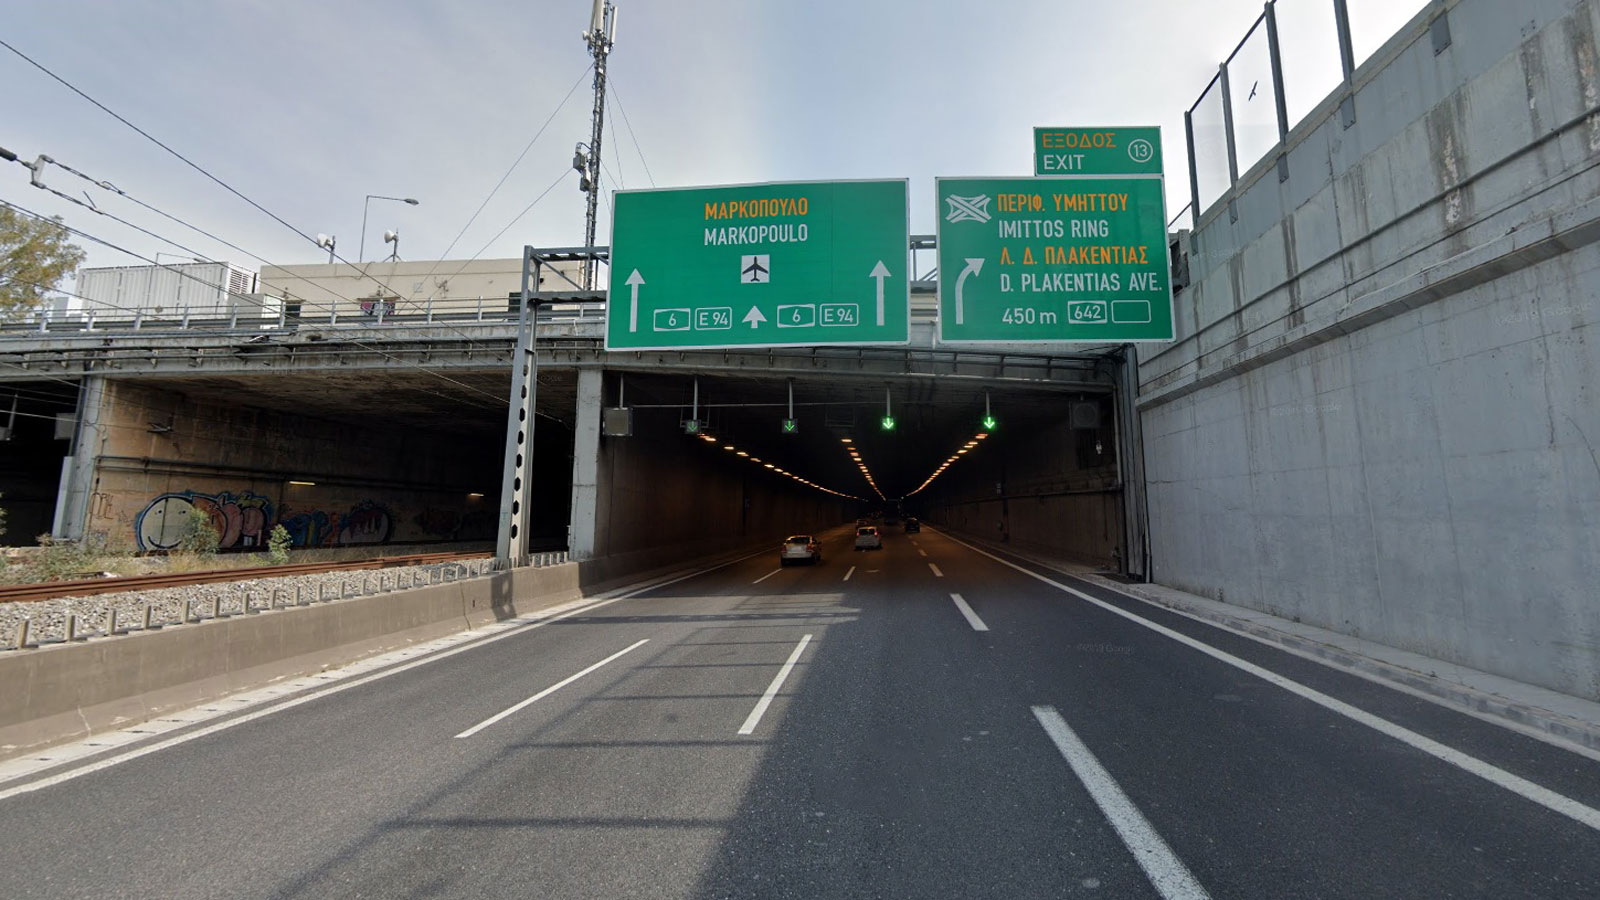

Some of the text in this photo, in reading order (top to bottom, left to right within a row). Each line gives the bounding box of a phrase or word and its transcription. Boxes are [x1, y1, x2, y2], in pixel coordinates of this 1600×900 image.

[1042, 133, 1116, 148] ΕΞΟΔΟΣ
[1133, 144, 1148, 157] 13
[1043, 154, 1084, 170] EXIT
[704, 197, 808, 220] ΜΑΡΚΟΠΟΥΛΟ
[998, 193, 1128, 212] ΠΕΡΙΦ. ΥΜΗΤΤΟΥ
[703, 224, 808, 246] MARKOPOULO
[998, 220, 1109, 238] IMITTOS RING
[1000, 246, 1149, 265] Λ. Δ. ΠΛΑΚΕΝΤΙΑΣ
[1000, 272, 1162, 292] D. PLAKENTIAS AVE.
[668, 312, 677, 327] 6
[792, 308, 801, 323] 6
[1074, 305, 1101, 320] 642
